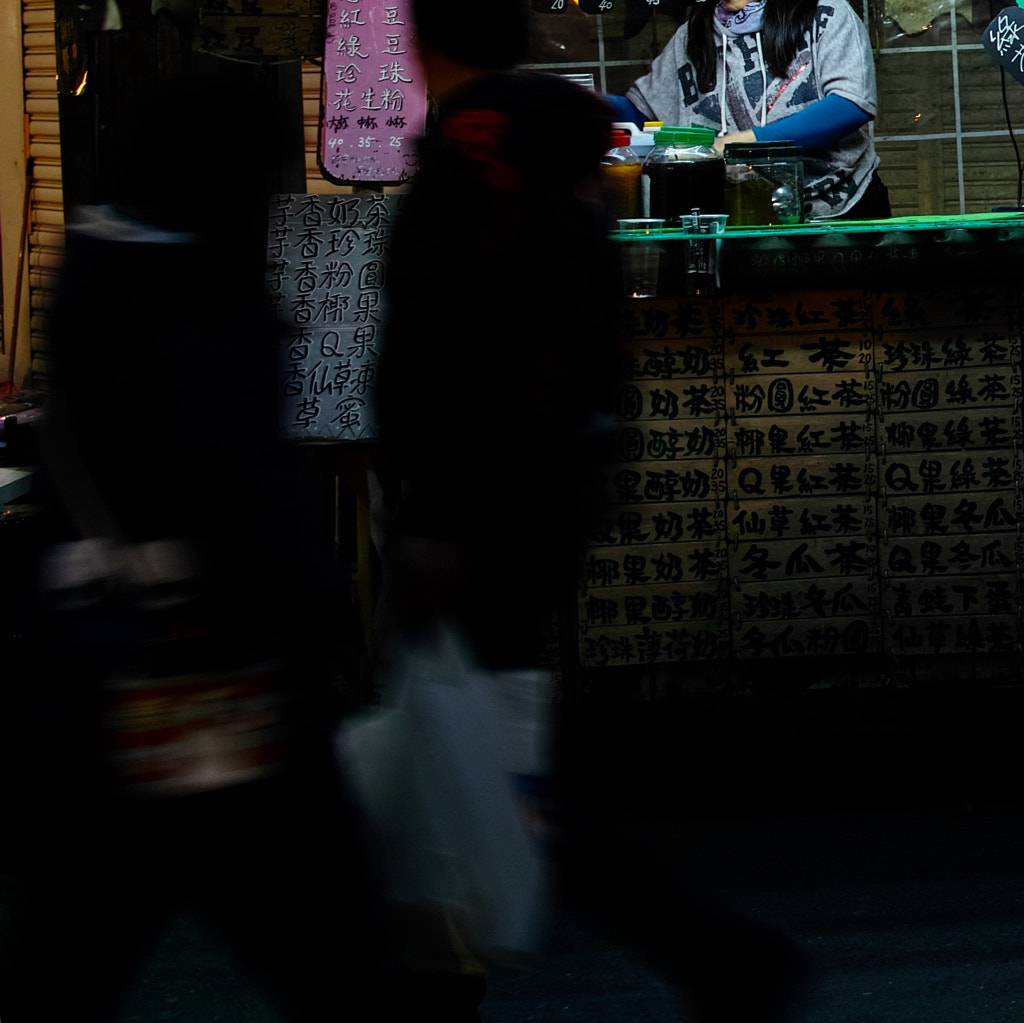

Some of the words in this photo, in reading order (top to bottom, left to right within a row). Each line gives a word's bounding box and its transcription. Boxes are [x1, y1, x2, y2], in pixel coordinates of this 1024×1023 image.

[598, 0, 613, 10] 40
[339, 7, 405, 29] 紅豆
[337, 34, 406, 58] 綠豆
[335, 63, 413, 85] 珍珠
[332, 87, 405, 112] 花生粉
[328, 137, 345, 149] 40
[357, 136, 376, 148] 35
[389, 136, 405, 147] 25
[270, 194, 392, 227] 芋香奶茶
[268, 226, 392, 260] 芋香珍珠
[266, 259, 387, 294] 芋香粉圓
[622, 303, 705, 337] 奶茶
[738, 337, 855, 372] 紅茶
[858, 339, 872, 351] 10
[880, 332, 1008, 371] 珍珠綠茶
[858, 353, 872, 364] 20
[710, 385, 725, 398] 20
[733, 378, 865, 414] 粉圓紅茶
[880, 374, 1010, 410] 粉圓綠茶
[711, 468, 724, 480] 20
[711, 481, 726, 492] 35
[732, 505, 863, 537] 仙草紅茶
[739, 541, 868, 579] 冬瓜茶
